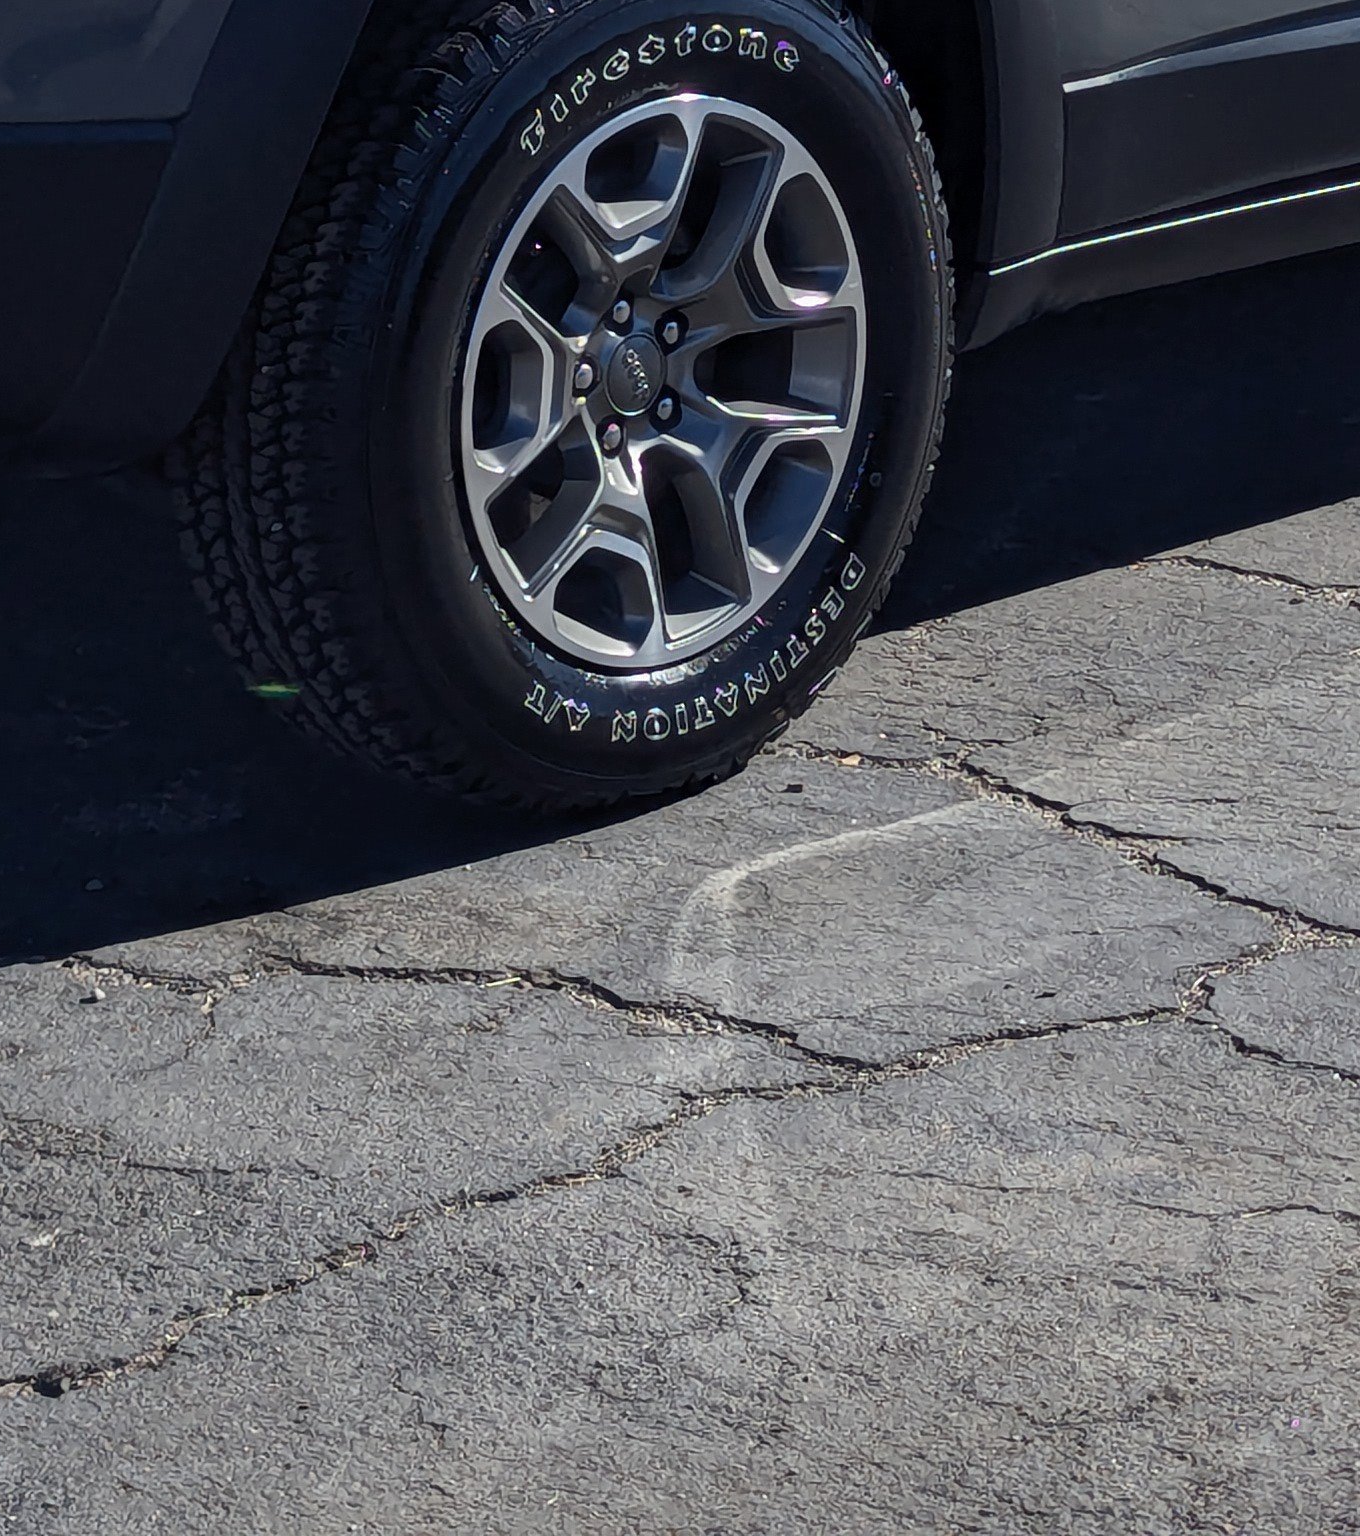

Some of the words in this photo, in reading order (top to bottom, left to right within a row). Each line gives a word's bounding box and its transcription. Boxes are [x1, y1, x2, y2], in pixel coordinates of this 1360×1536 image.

[520, 21, 800, 155] Firestone
[524, 680, 591, 742] A/T
[611, 552, 866, 743] DESTINATION
